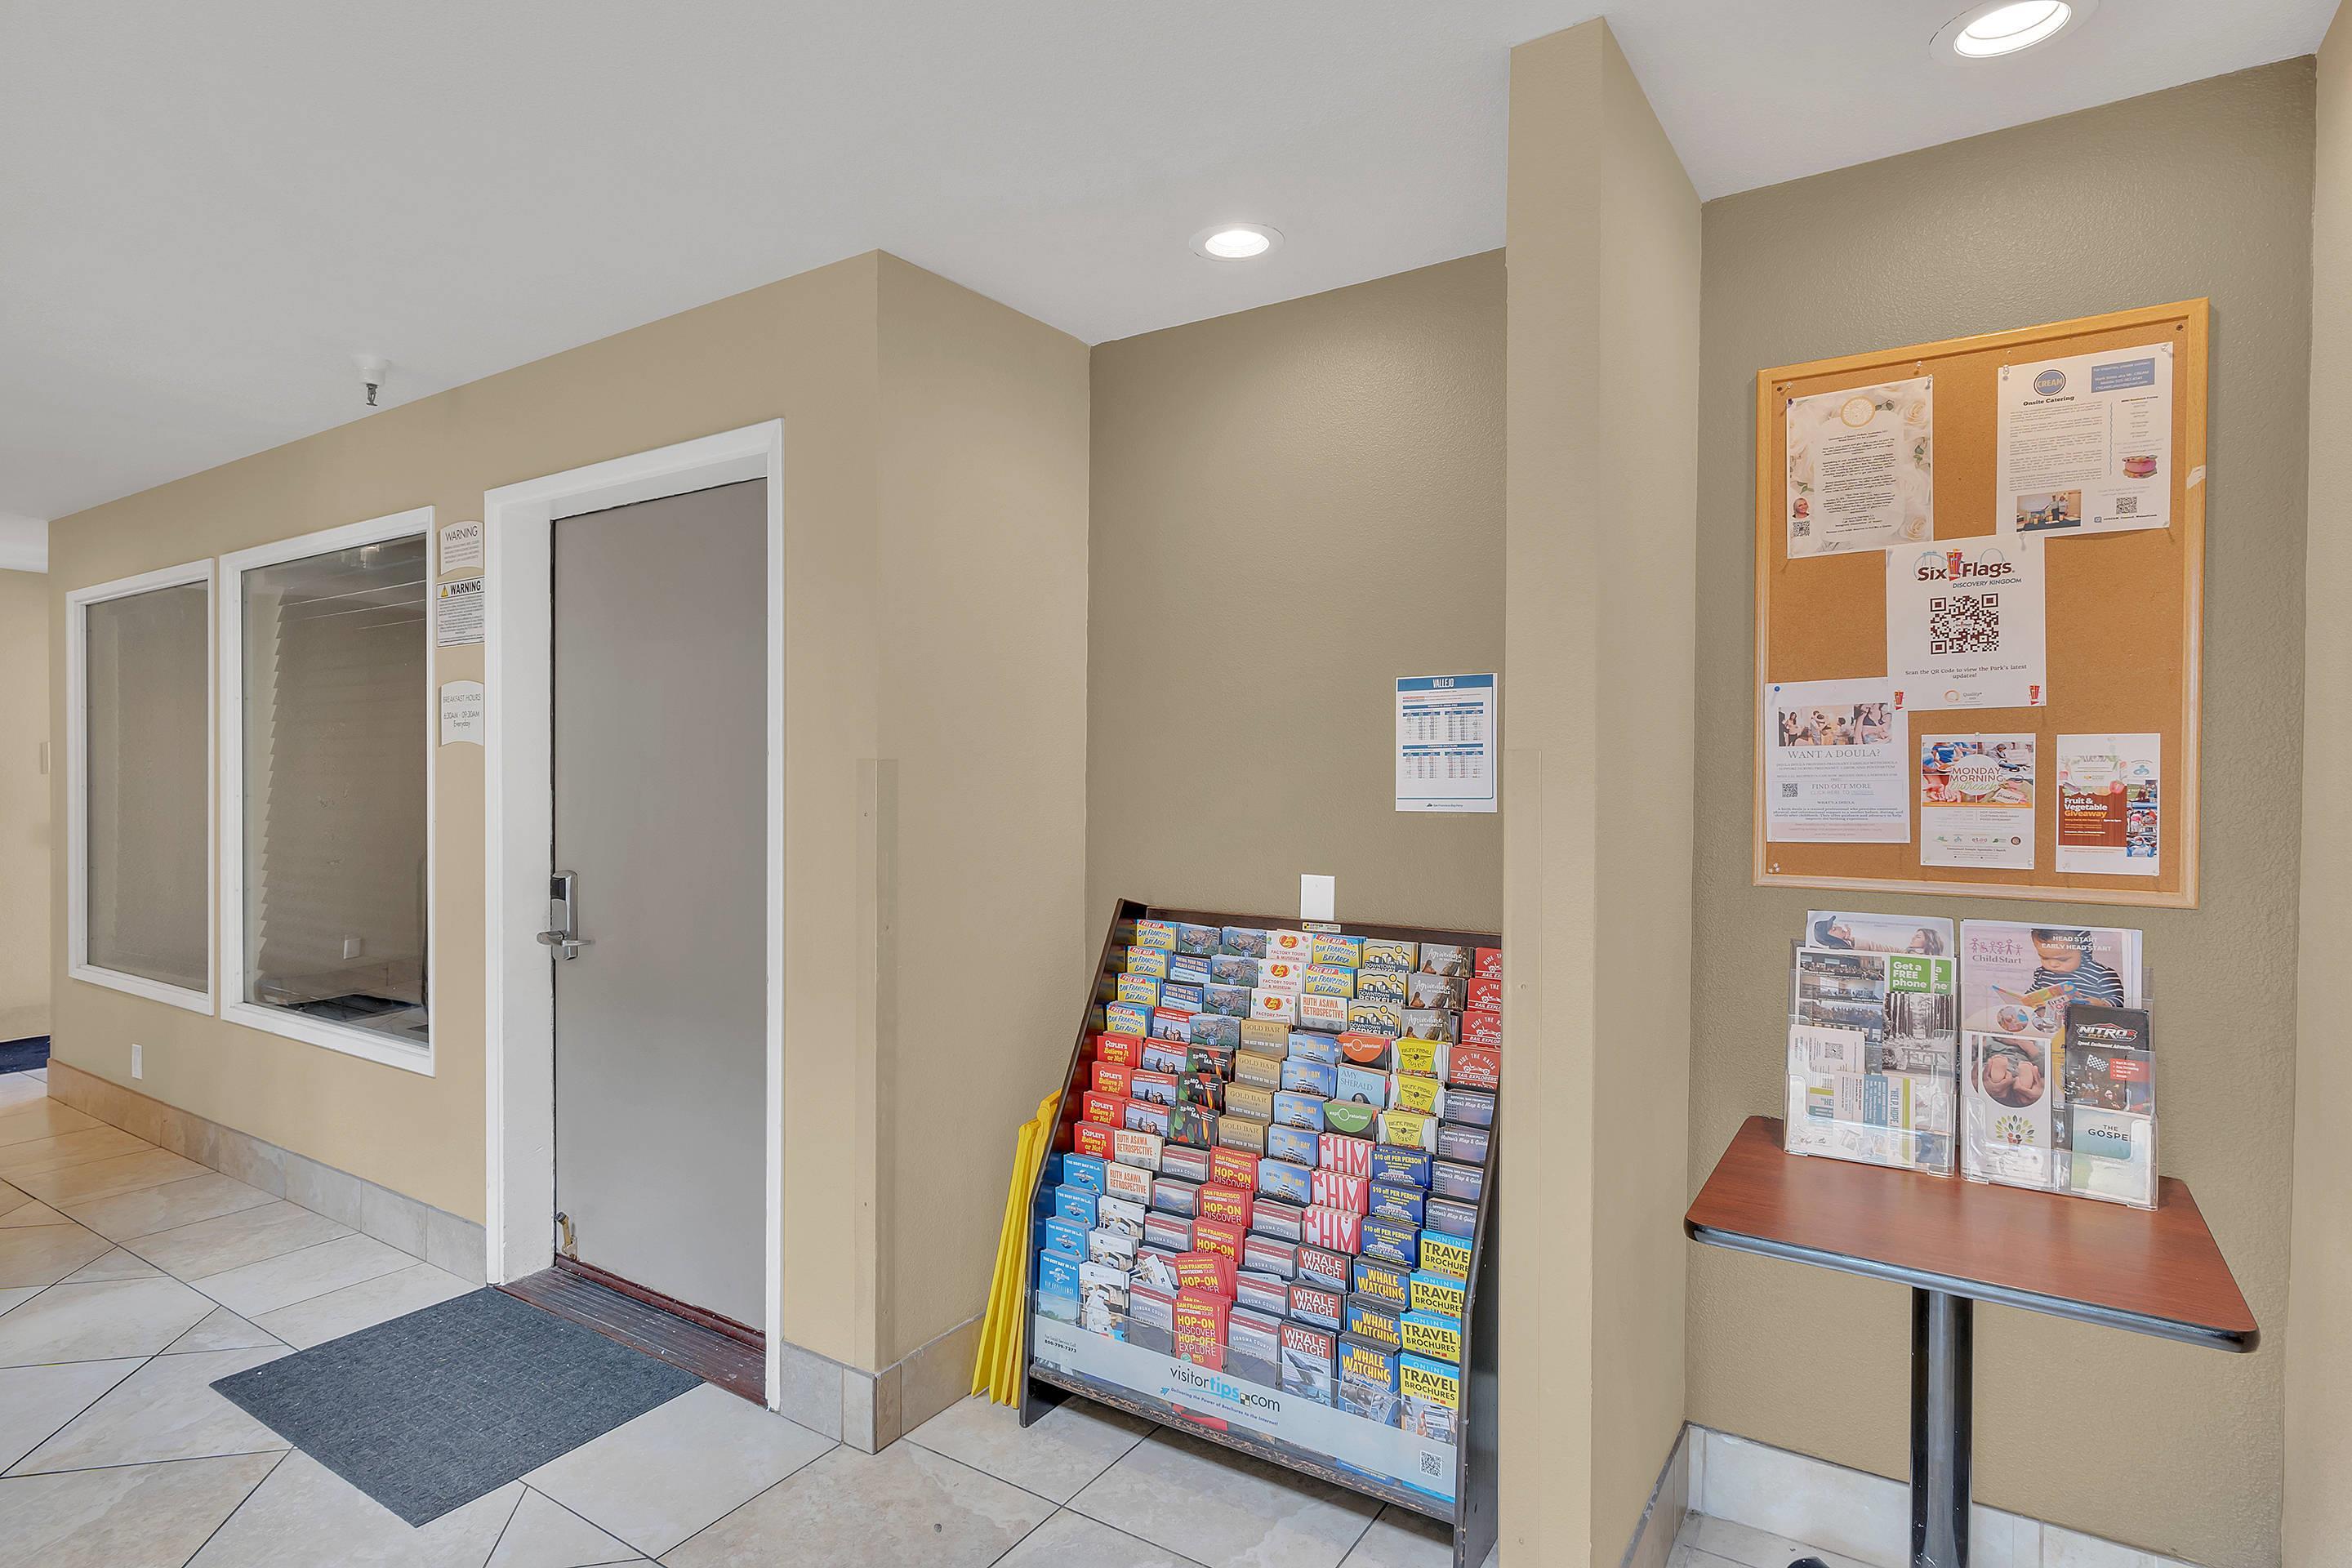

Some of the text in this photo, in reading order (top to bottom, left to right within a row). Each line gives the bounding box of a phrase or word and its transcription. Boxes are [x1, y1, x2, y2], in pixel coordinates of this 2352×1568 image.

[2037, 376, 2063, 389] CREAM
[2023, 395, 2074, 407] Onsite Catering
[445, 525, 478, 541] WARNING
[1917, 562, 2012, 581] Six Flags
[451, 581, 481, 595] WARNING
[1953, 581, 1988, 589] DISCOVERY
[1432, 679, 1454, 688] VALLEJO
[1788, 751, 1823, 759] WANT
[1836, 748, 1881, 758] DOULA?
[2065, 810, 2107, 818] Giveaway
[1315, 945, 1356, 957] SAN FRANCISCO
[1323, 954, 1350, 963] BAY AREA
[1893, 961, 1913, 971] Get
[1893, 970, 1918, 979] FREE
[1892, 979, 1927, 989] phone
[1359, 990, 1390, 999] DOWNTOWN
[1303, 997, 1339, 1009] RUTH ASAWA
[2047, 996, 2067, 1007] first
[1303, 1006, 1343, 1019] RETROSPECTIVE
[2079, 1027, 2127, 1039] NITRO
[1406, 1058, 1426, 1067] MUSEUM
[1459, 1055, 1469, 1065] RIDE
[1483, 1055, 1496, 1070] RAILS
[1341, 1070, 1357, 1079] AMY
[1469, 1073, 1497, 1082] EXPLORERS
[1340, 1078, 1373, 1092] SHERALD
[2087, 1129, 2132, 1142] GOSPE
[1226, 1156, 1251, 1167] FRANCISCO
[1214, 1166, 1251, 1183] HOP-ON
[1214, 1175, 1251, 1189] DISCOVER
[1401, 1192, 1420, 1201] PERSON
[1277, 1227, 1294, 1238] COUNTY
[1301, 1250, 1342, 1268] WHALE
[1303, 1260, 1340, 1278] WATCH
[1366, 1268, 1398, 1286] WHALE
[1423, 1276, 1454, 1287] ONLINE
[1357, 1277, 1405, 1301] WATCHING
[1186, 1303, 1213, 1312] FRANCISCO
[1177, 1315, 1215, 1329] HOP-ON
[1178, 1325, 1215, 1337] DISCOVER
[1178, 1333, 1215, 1347] HOP-OFF
[1285, 1328, 1326, 1348] WHALE
[1179, 1342, 1216, 1356] EXPLORE
[1287, 1339, 1325, 1357] WATCH
[1352, 1348, 1384, 1367] WHALE
[1342, 1356, 1391, 1383] WATCHING
[1413, 1361, 1445, 1375] ONLINE
[1403, 1367, 1456, 1392] TRAVEL
[1405, 1381, 1455, 1401] BROCHURES
[1171, 1388, 1192, 1399] Delivering
[1200, 1396, 1215, 1405] Power
[1222, 1405, 1244, 1414] Brochures
